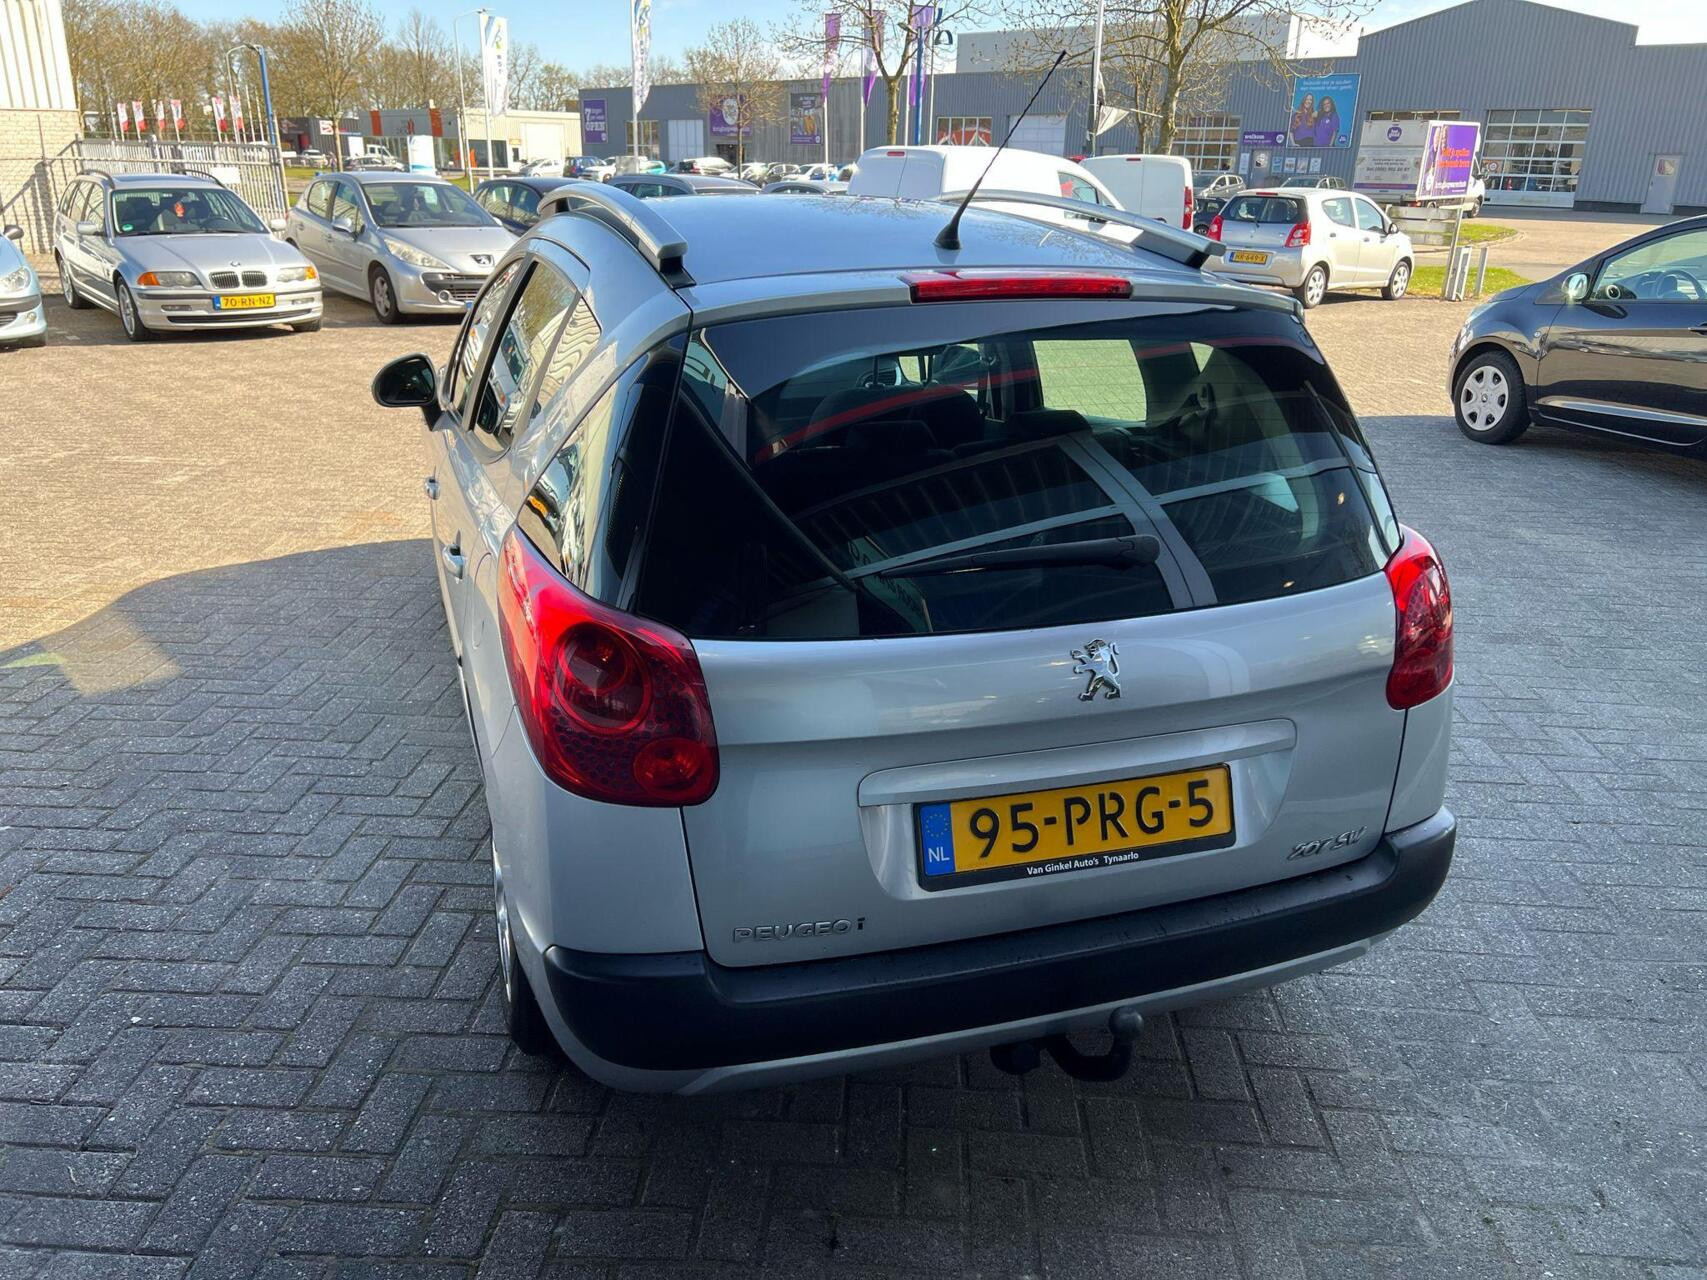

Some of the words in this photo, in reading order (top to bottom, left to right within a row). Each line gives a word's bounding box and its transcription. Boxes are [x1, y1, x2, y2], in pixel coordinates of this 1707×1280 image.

[969, 779, 1214, 859] 95-PRG-5
[928, 847, 950, 864] NL
[1027, 864, 1042, 875] Van
[1044, 860, 1073, 874] Ginkel
[1073, 856, 1100, 868] Auto's
[1103, 851, 1140, 864] Tynaarlo
[733, 916, 866, 943] PEUGEOT
